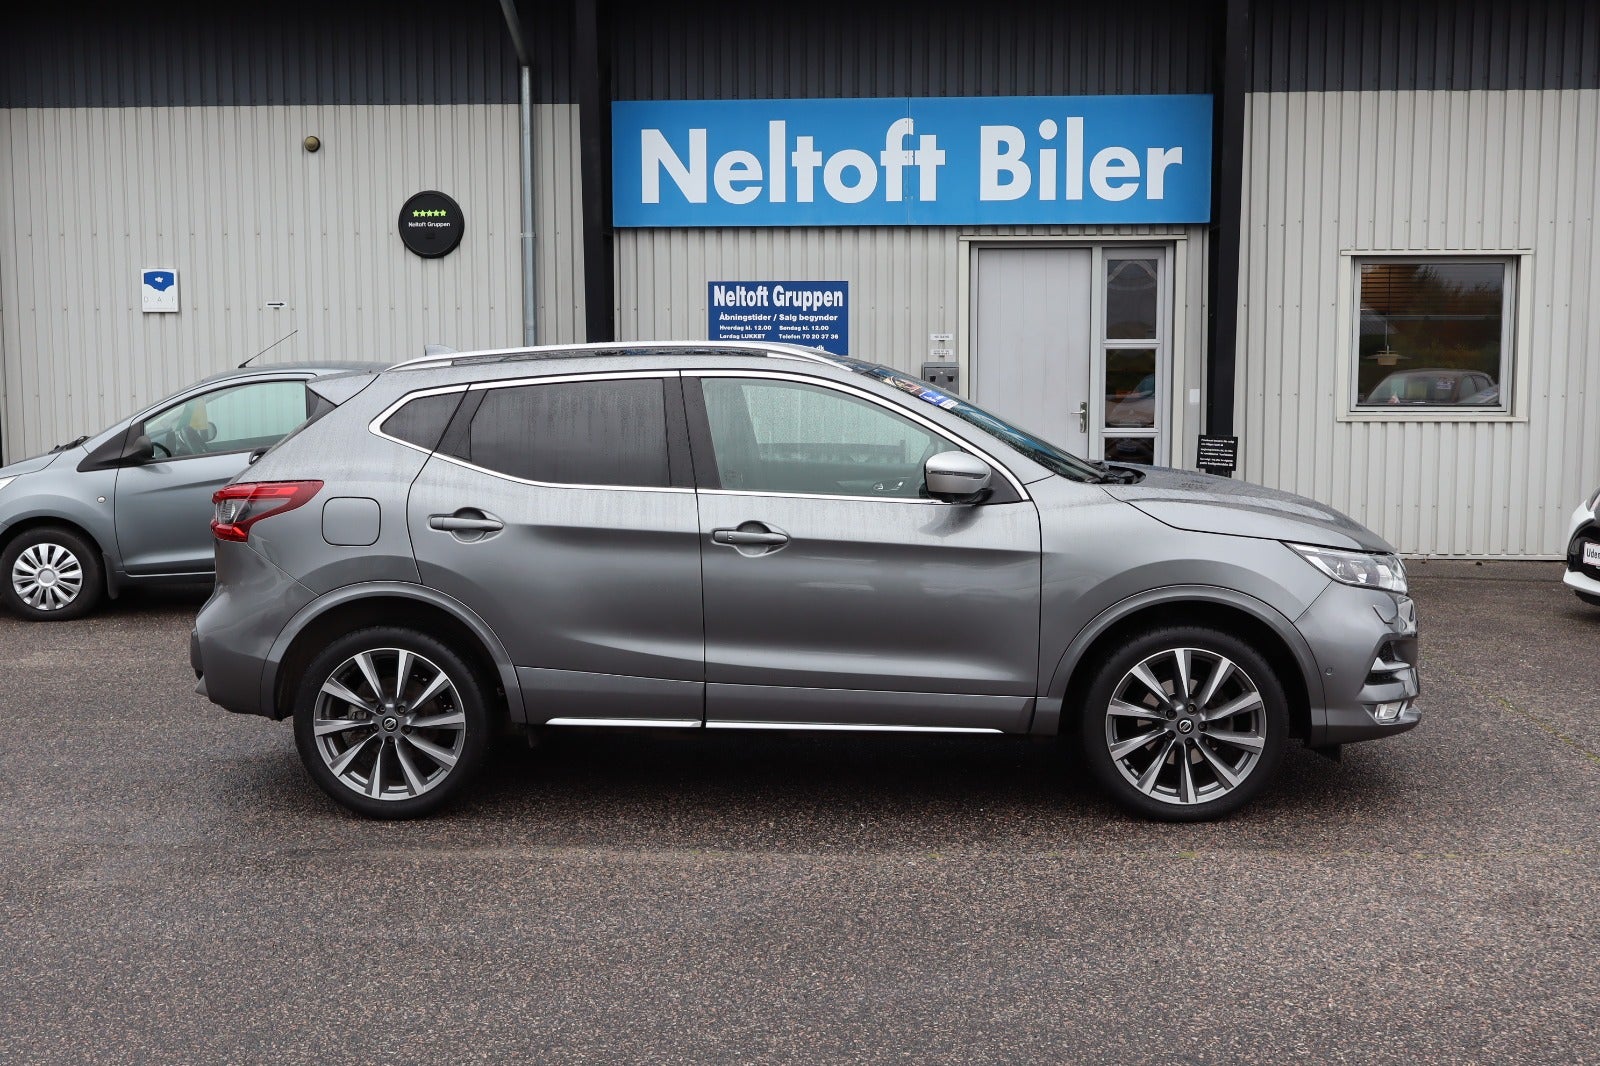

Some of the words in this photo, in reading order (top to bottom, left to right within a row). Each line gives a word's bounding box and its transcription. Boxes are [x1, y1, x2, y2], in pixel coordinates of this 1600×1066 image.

[641, 118, 945, 205] Neltoft
[980, 116, 1183, 202] Biler
[713, 285, 769, 307] Neltoft
[772, 285, 843, 311] Gruppen
[719, 312, 772, 322] Åbningstider
[779, 313, 797, 322] Salg
[799, 313, 838, 322] begynder
